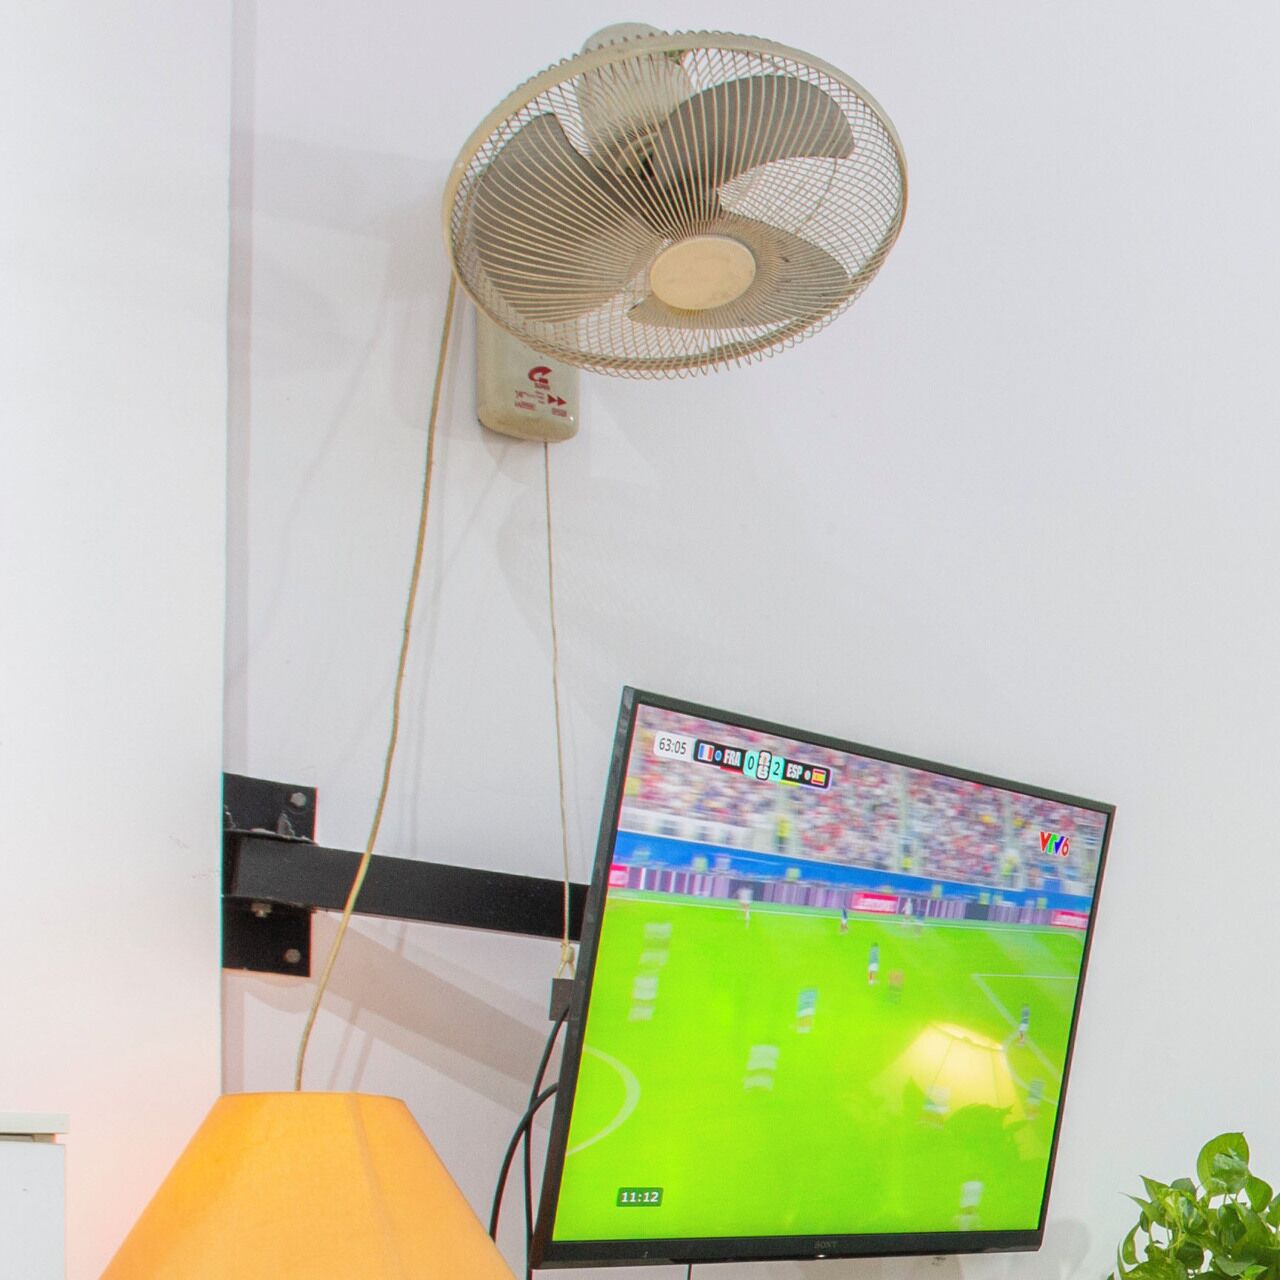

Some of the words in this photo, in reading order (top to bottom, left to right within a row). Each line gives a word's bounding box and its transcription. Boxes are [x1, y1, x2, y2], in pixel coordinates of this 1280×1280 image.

[658, 736, 687, 755] 63:05
[723, 748, 741, 767] FRA
[747, 757, 755, 770] 0
[773, 762, 780, 776] 2
[786, 763, 802, 779] ESP
[1039, 831, 1070, 857] VTV6
[621, 1191, 660, 1203] 11:12
